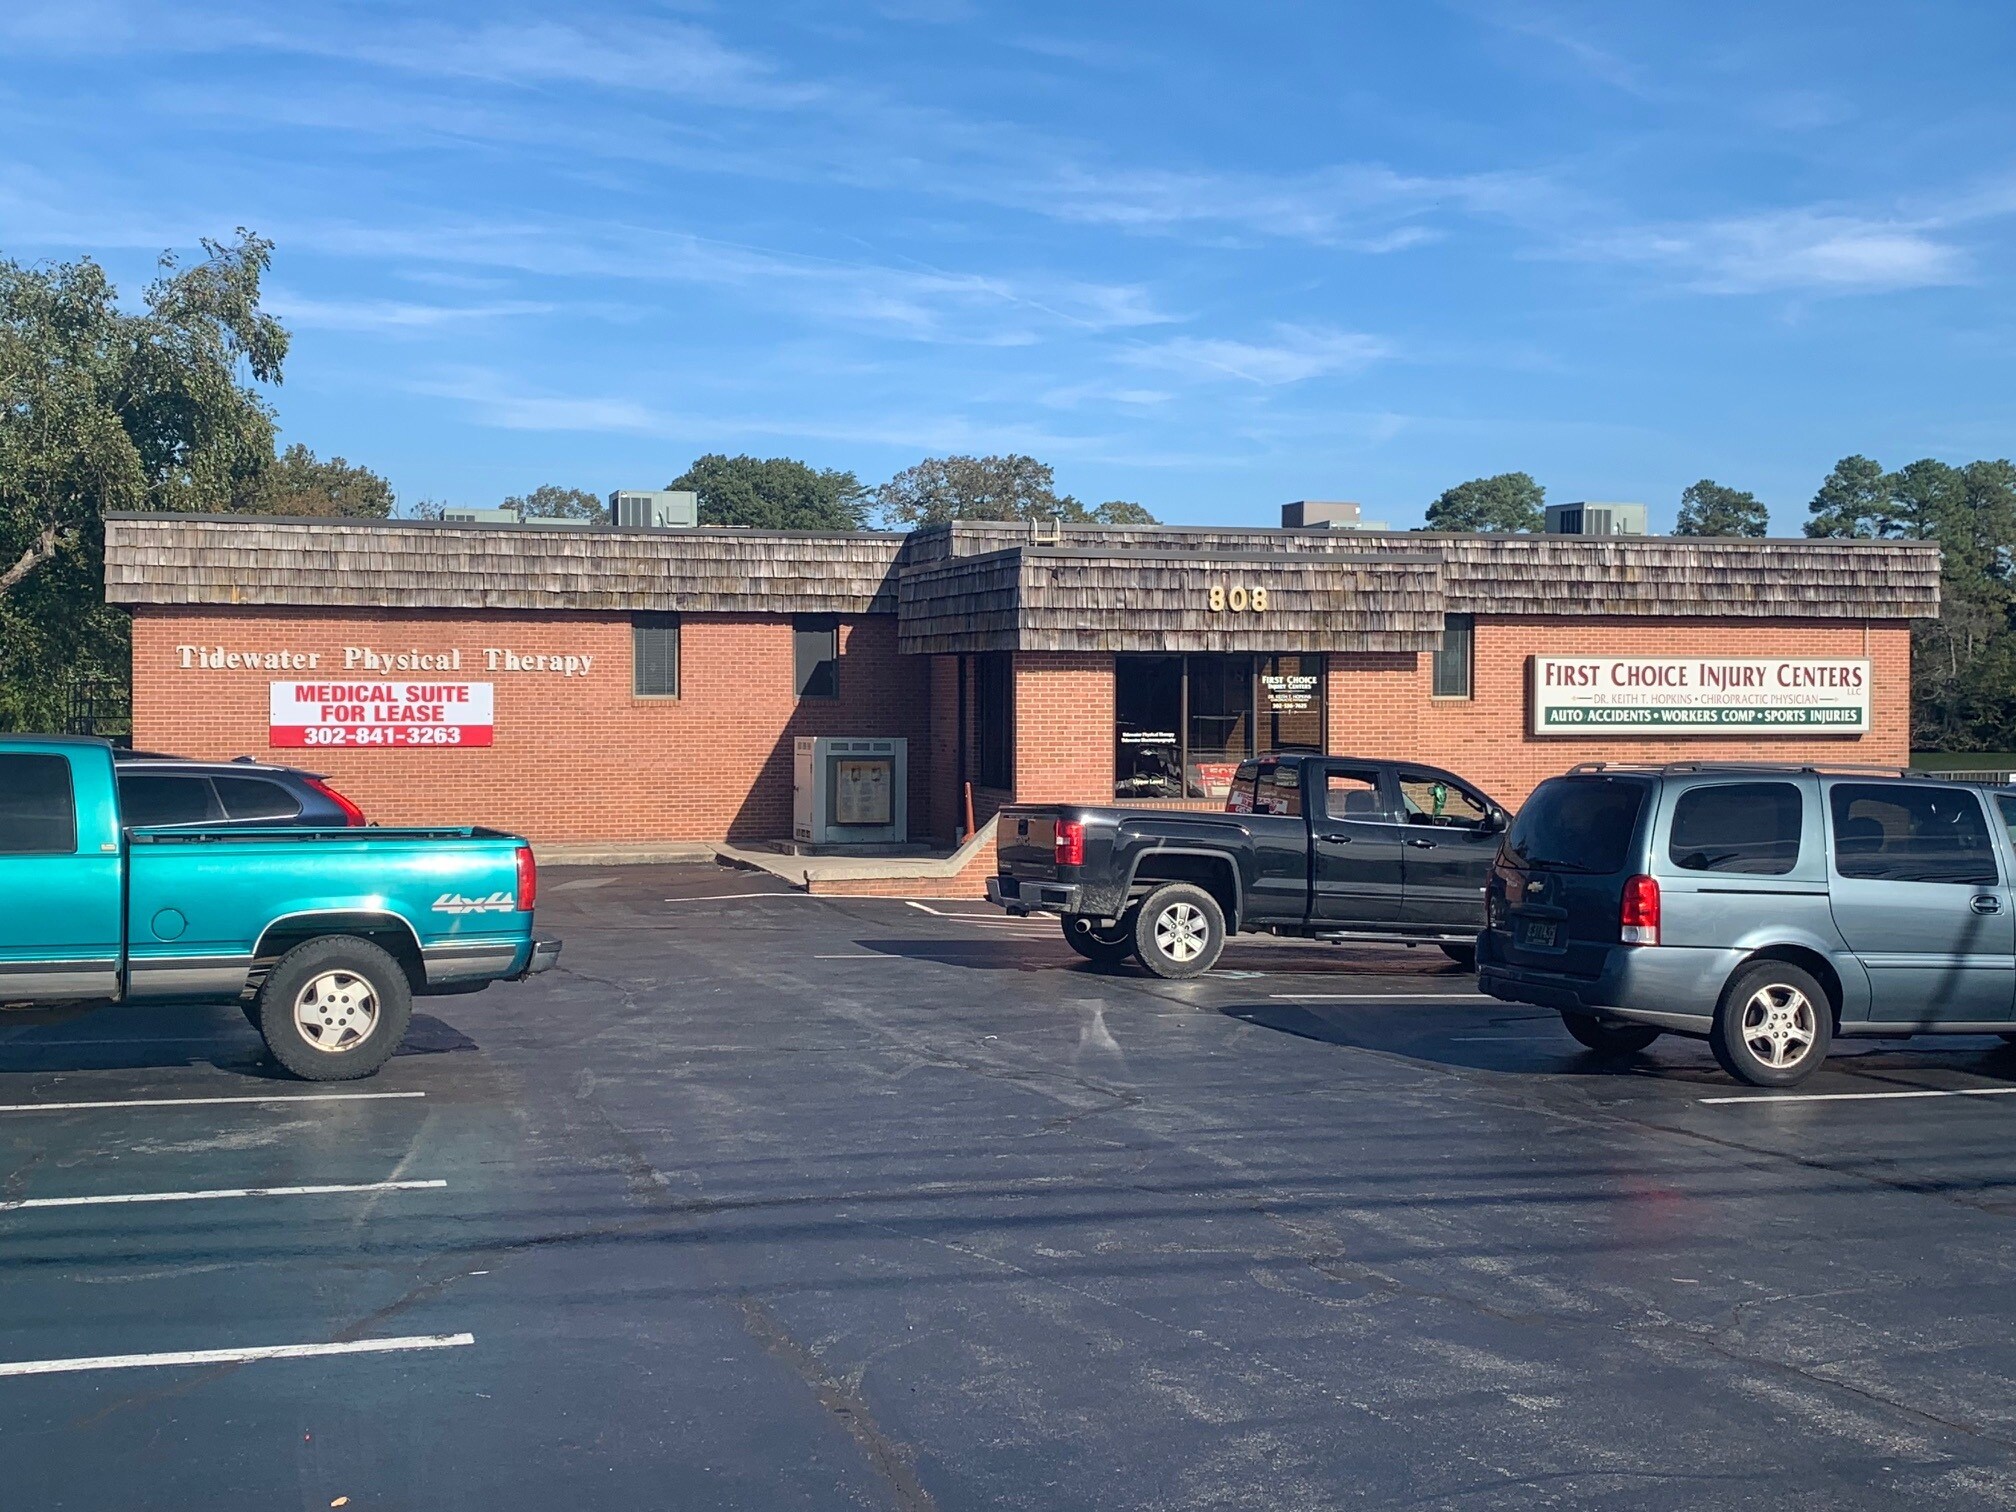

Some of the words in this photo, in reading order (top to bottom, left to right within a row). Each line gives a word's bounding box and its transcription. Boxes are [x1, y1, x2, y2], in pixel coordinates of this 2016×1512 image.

[1209, 585, 1268, 612] 808
[176, 645, 321, 670] Tidewater
[343, 646, 461, 675] Physical
[483, 648, 594, 677] Therapy
[1286, 676, 1317, 684] CHOICE
[1545, 663, 1600, 686] FIRST
[1611, 663, 1688, 687] CHOICE
[1699, 664, 1767, 692] INJURY
[1777, 664, 1862, 687] CENTERS
[295, 685, 398, 703] MEDICAL
[405, 685, 469, 703] SUITE
[1594, 694, 1609, 704] DR.
[1611, 694, 1639, 704] KEITH
[1641, 694, 1649, 704] T.
[1651, 694, 1692, 704] HOPKINS
[1701, 694, 1769, 705] CHIROPRACTIC
[1770, 694, 1819, 705] PHYSICIAN
[1847, 688, 1862, 696] LLC
[321, 705, 365, 722] FOR
[374, 705, 444, 722] LEASE
[1550, 709, 1584, 722] AUTO
[1587, 709, 1652, 722] ACCIDENTS
[1661, 709, 1718, 722] WORKERS
[1721, 709, 1756, 722] COMP
[1764, 709, 1806, 722] SPORTS
[1810, 709, 1857, 724] INJURIES
[304, 727, 461, 744] 302-841-3263
[431, 892, 514, 914] 4x4
